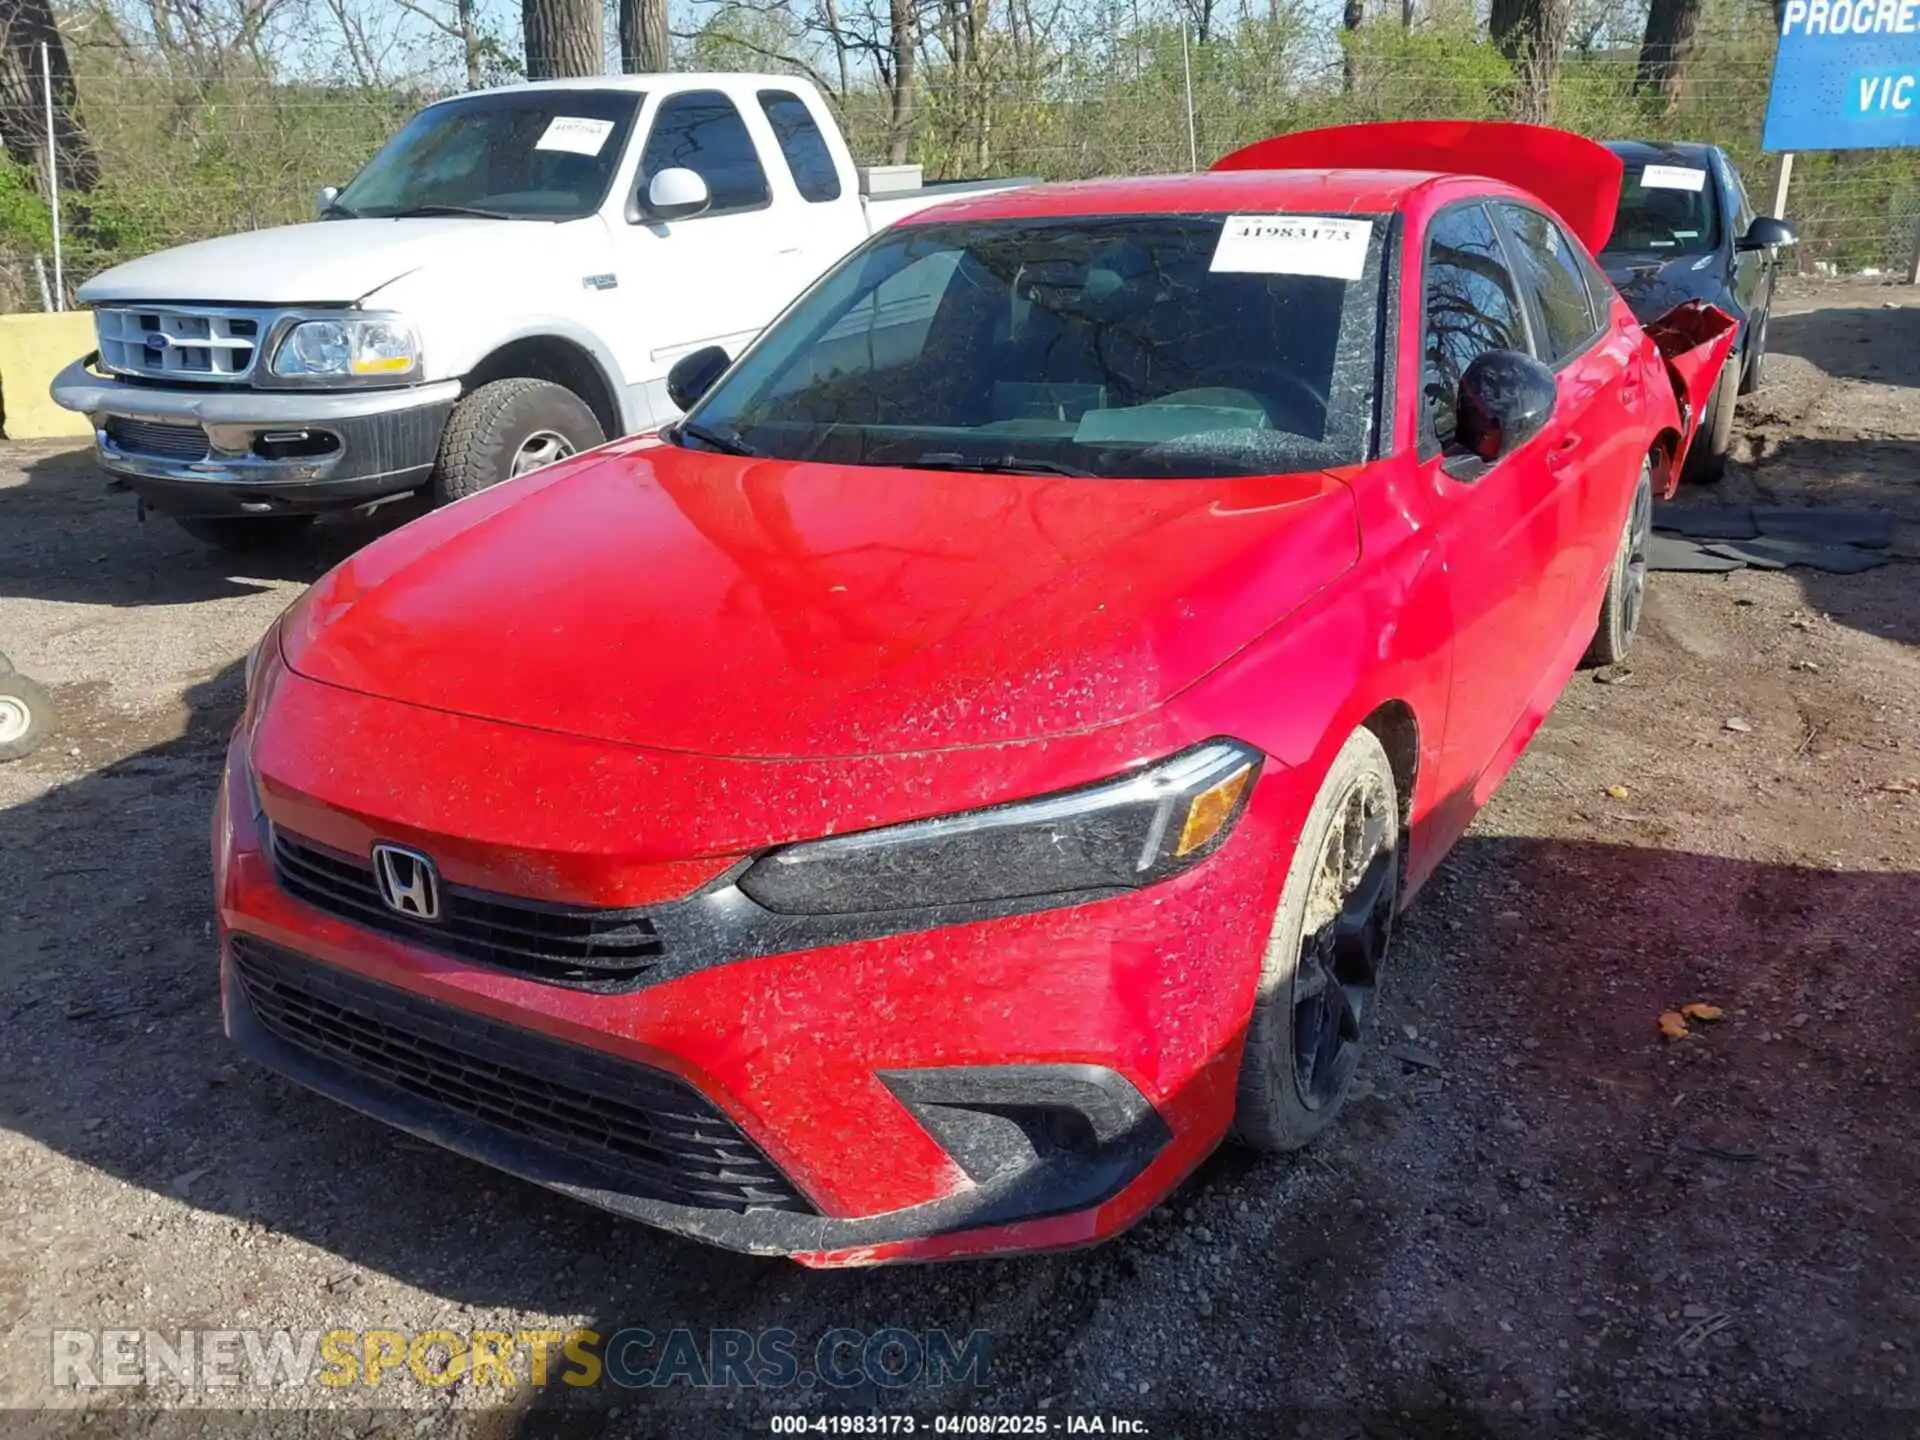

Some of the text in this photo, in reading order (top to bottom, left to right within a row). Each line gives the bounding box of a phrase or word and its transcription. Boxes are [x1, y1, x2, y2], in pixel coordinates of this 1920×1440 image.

[1782, 0, 1920, 36] PROGRE
[1860, 75, 1915, 112] VIC
[1236, 226, 1350, 241] 41983173
